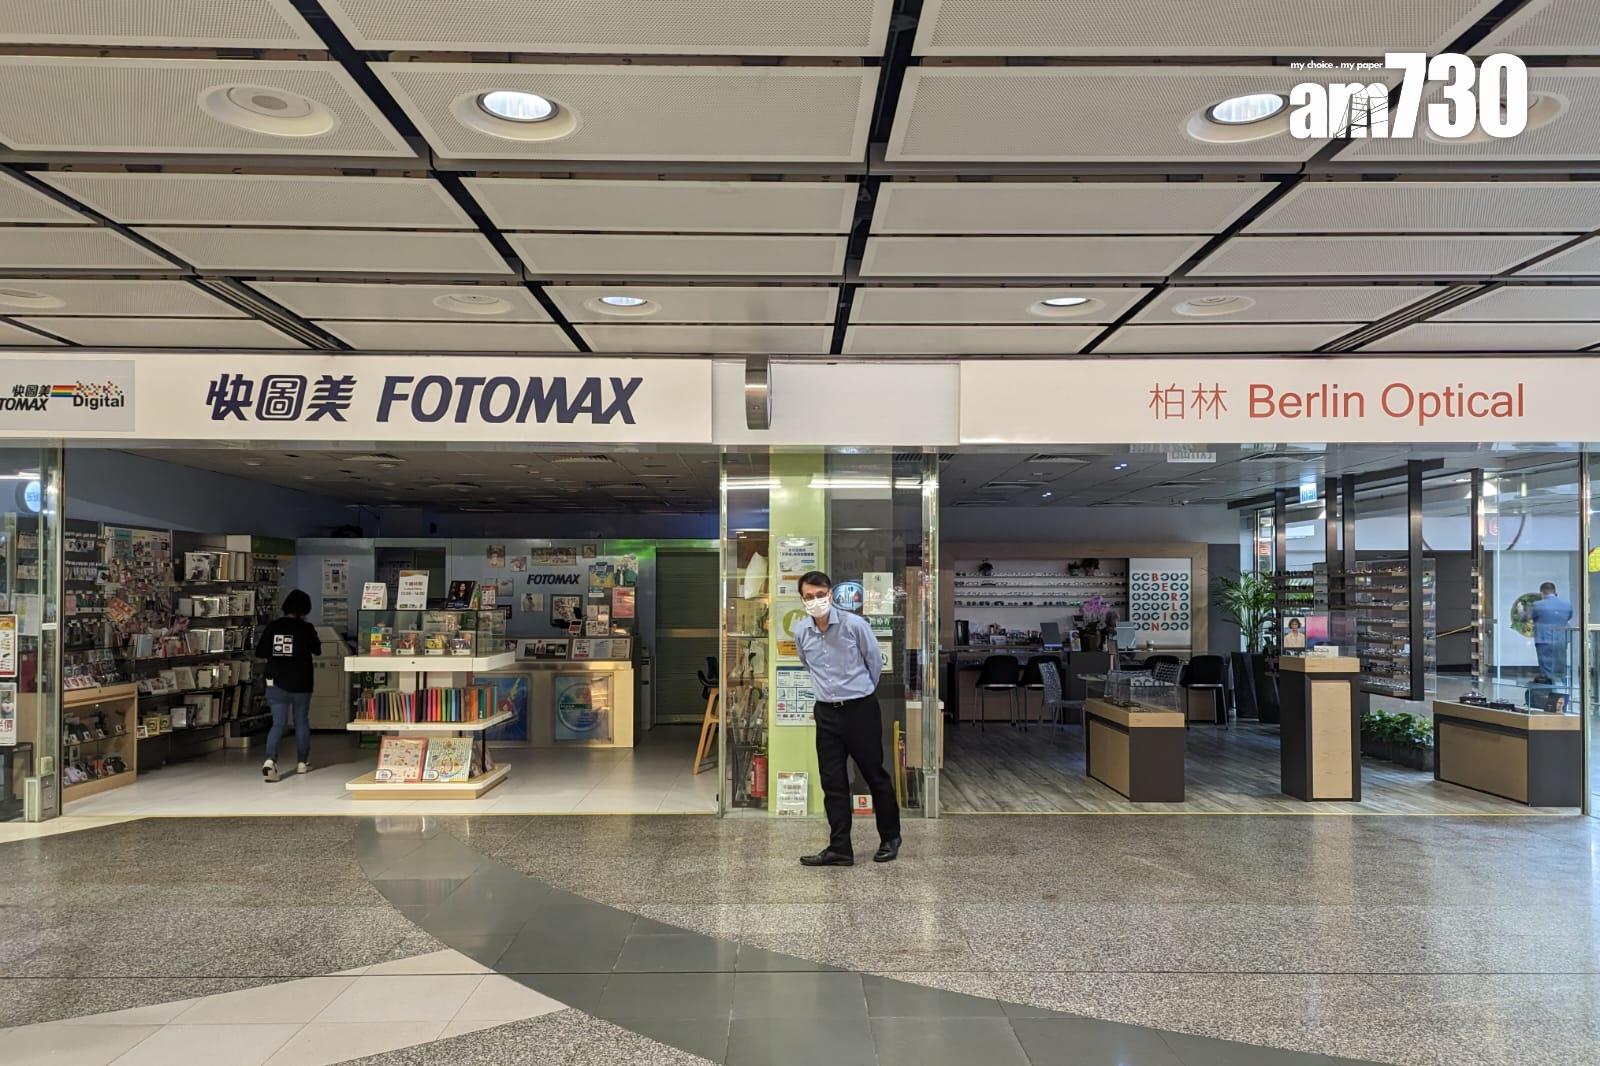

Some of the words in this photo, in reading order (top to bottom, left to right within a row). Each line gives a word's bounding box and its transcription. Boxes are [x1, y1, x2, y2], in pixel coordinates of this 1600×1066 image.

[12, 384, 52, 398] 快圖美
[206, 374, 357, 422] 快圖美
[376, 375, 644, 425] FOTOMAX
[73, 394, 125, 411] Digital
[1148, 382, 1228, 420] 柏林
[1249, 383, 1365, 419] Berlin
[1381, 382, 1525, 426] Optical
[526, 573, 581, 585] FOTOMAX
